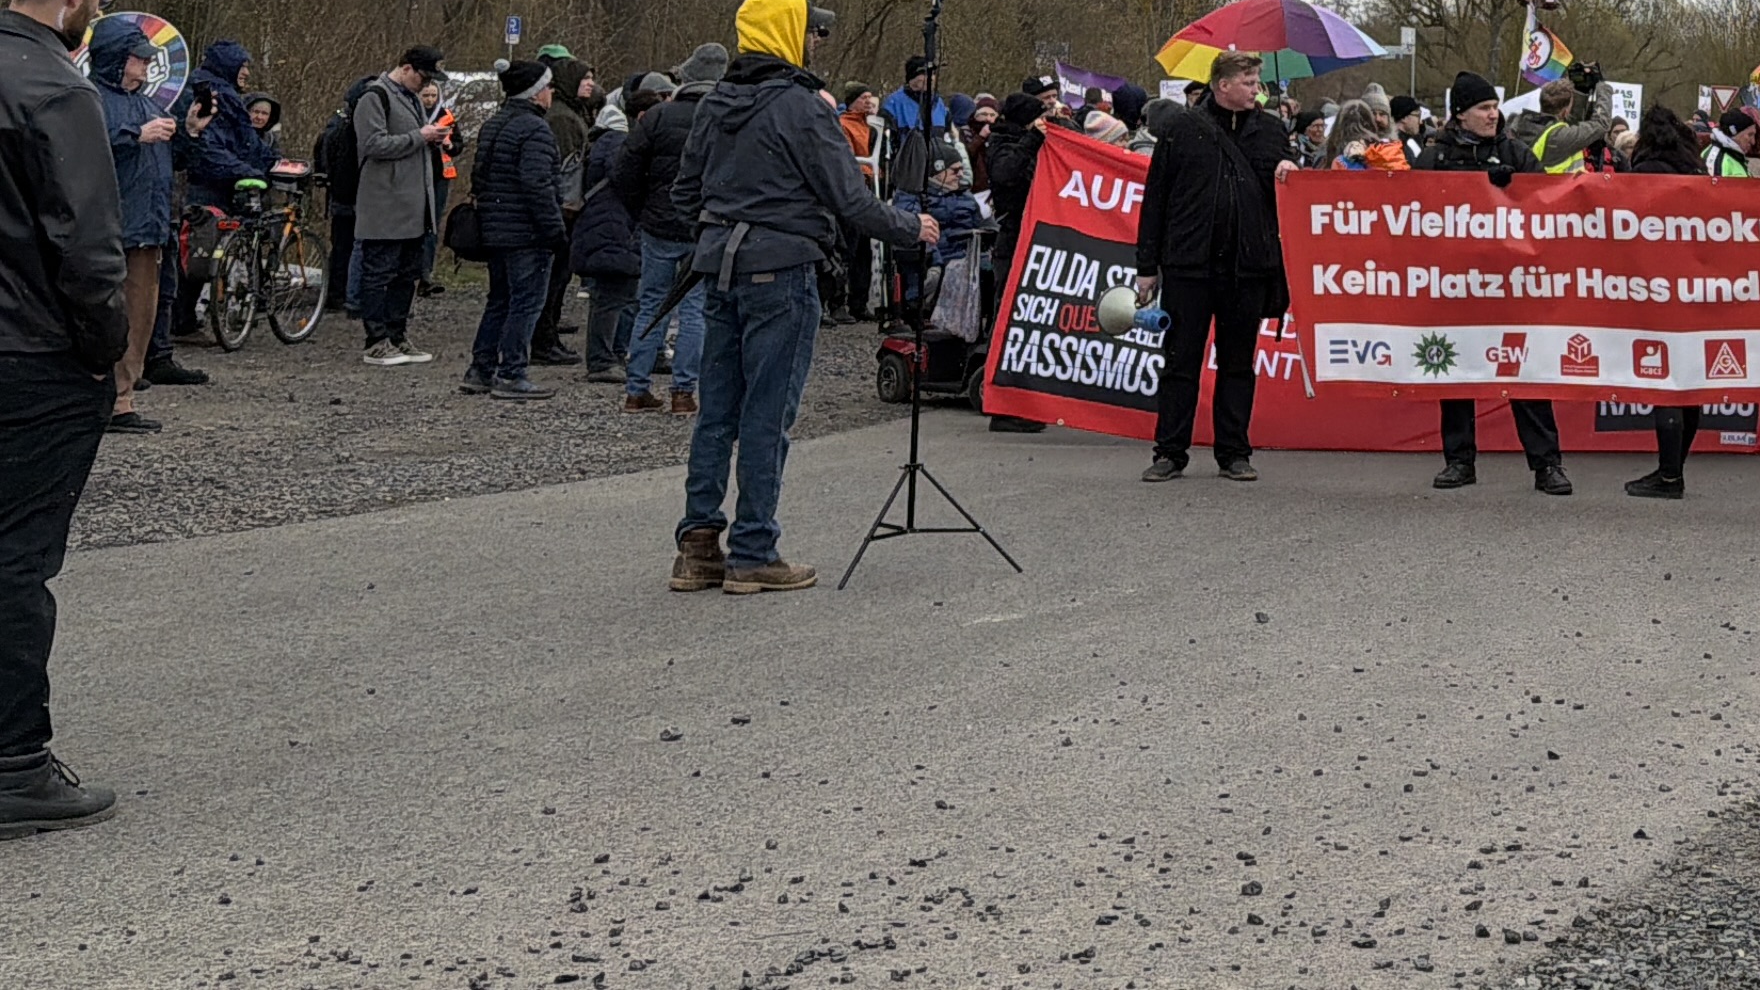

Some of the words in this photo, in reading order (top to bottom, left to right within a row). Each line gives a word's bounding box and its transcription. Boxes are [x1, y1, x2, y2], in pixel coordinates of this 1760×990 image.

[1310, 201, 1378, 236] Für
[1381, 200, 1526, 240] Vielfalt
[1531, 207, 1606, 240] und
[1021, 243, 1100, 301] FULDA
[1312, 260, 1401, 296] Kein
[1406, 266, 1506, 299] Platz
[1508, 266, 1571, 299] für
[1576, 267, 1671, 303] Hass
[1677, 270, 1760, 304] und
[1012, 292, 1060, 326] SICH
[1058, 302, 1101, 334] QUE
[1000, 326, 1167, 397] RASSISMUS
[1485, 346, 1529, 364] GEW
